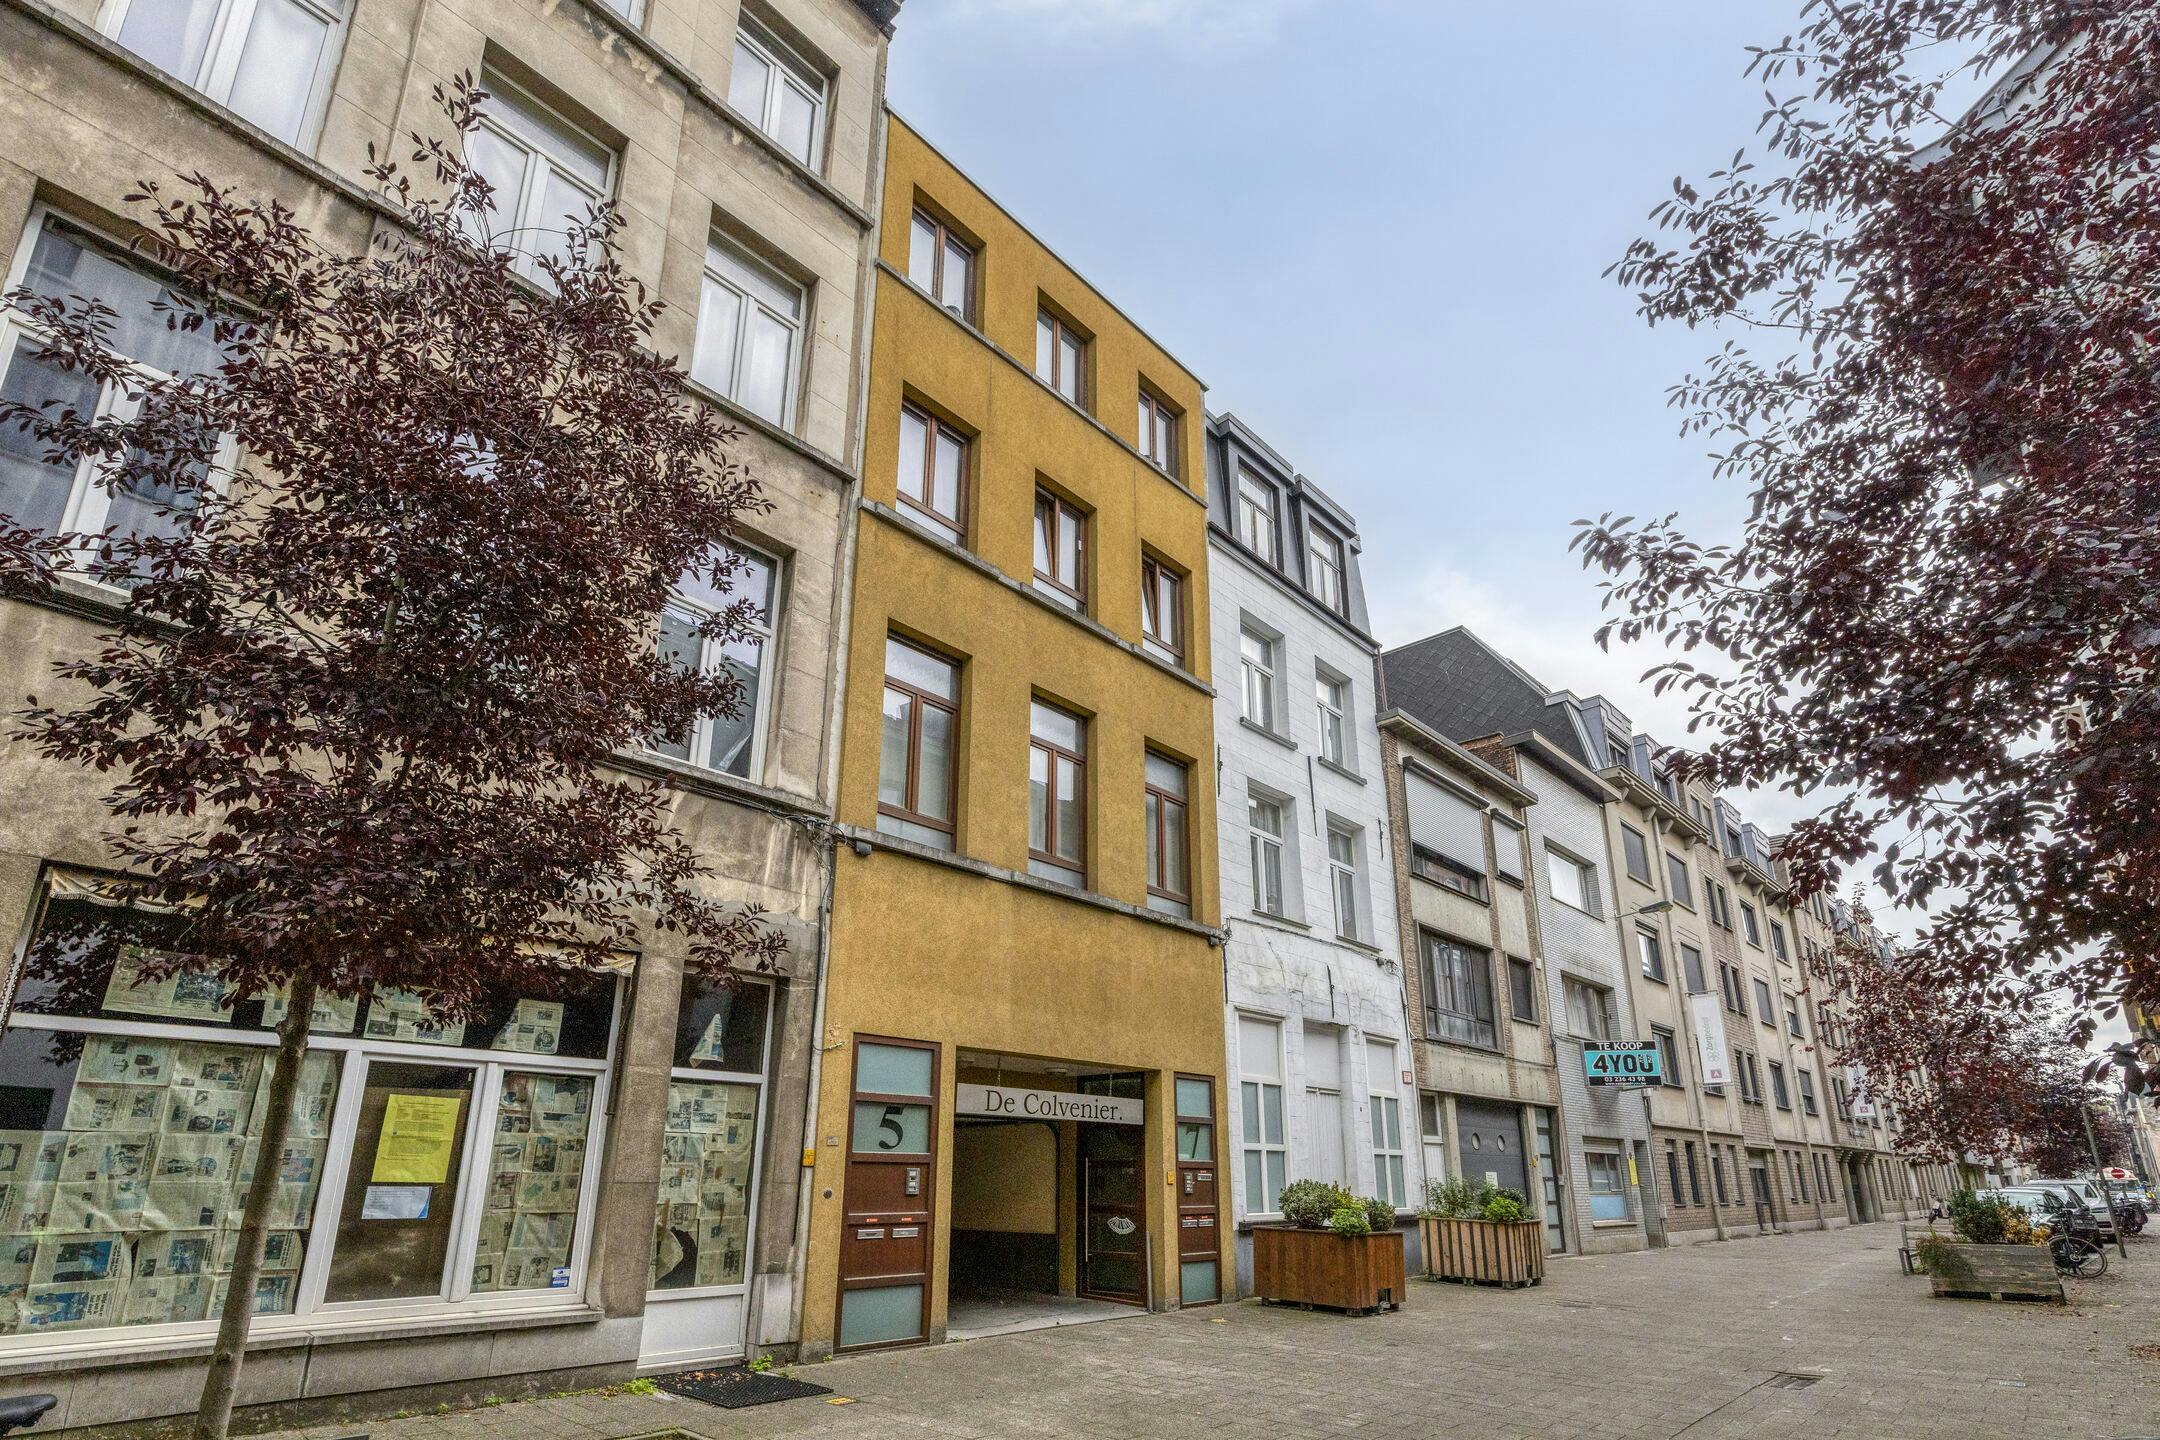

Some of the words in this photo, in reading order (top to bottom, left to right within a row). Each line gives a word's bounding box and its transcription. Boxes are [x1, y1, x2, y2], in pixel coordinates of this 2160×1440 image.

[1596, 1042, 1610, 1050] TE
[1614, 1042, 1643, 1050] KOOP
[1593, 1054, 1654, 1073] 4YOU
[984, 1089, 1016, 1113] De
[1023, 1093, 1123, 1121] Colvenier.
[878, 1105, 905, 1150] 5
[1186, 1123, 1200, 1159] 7
